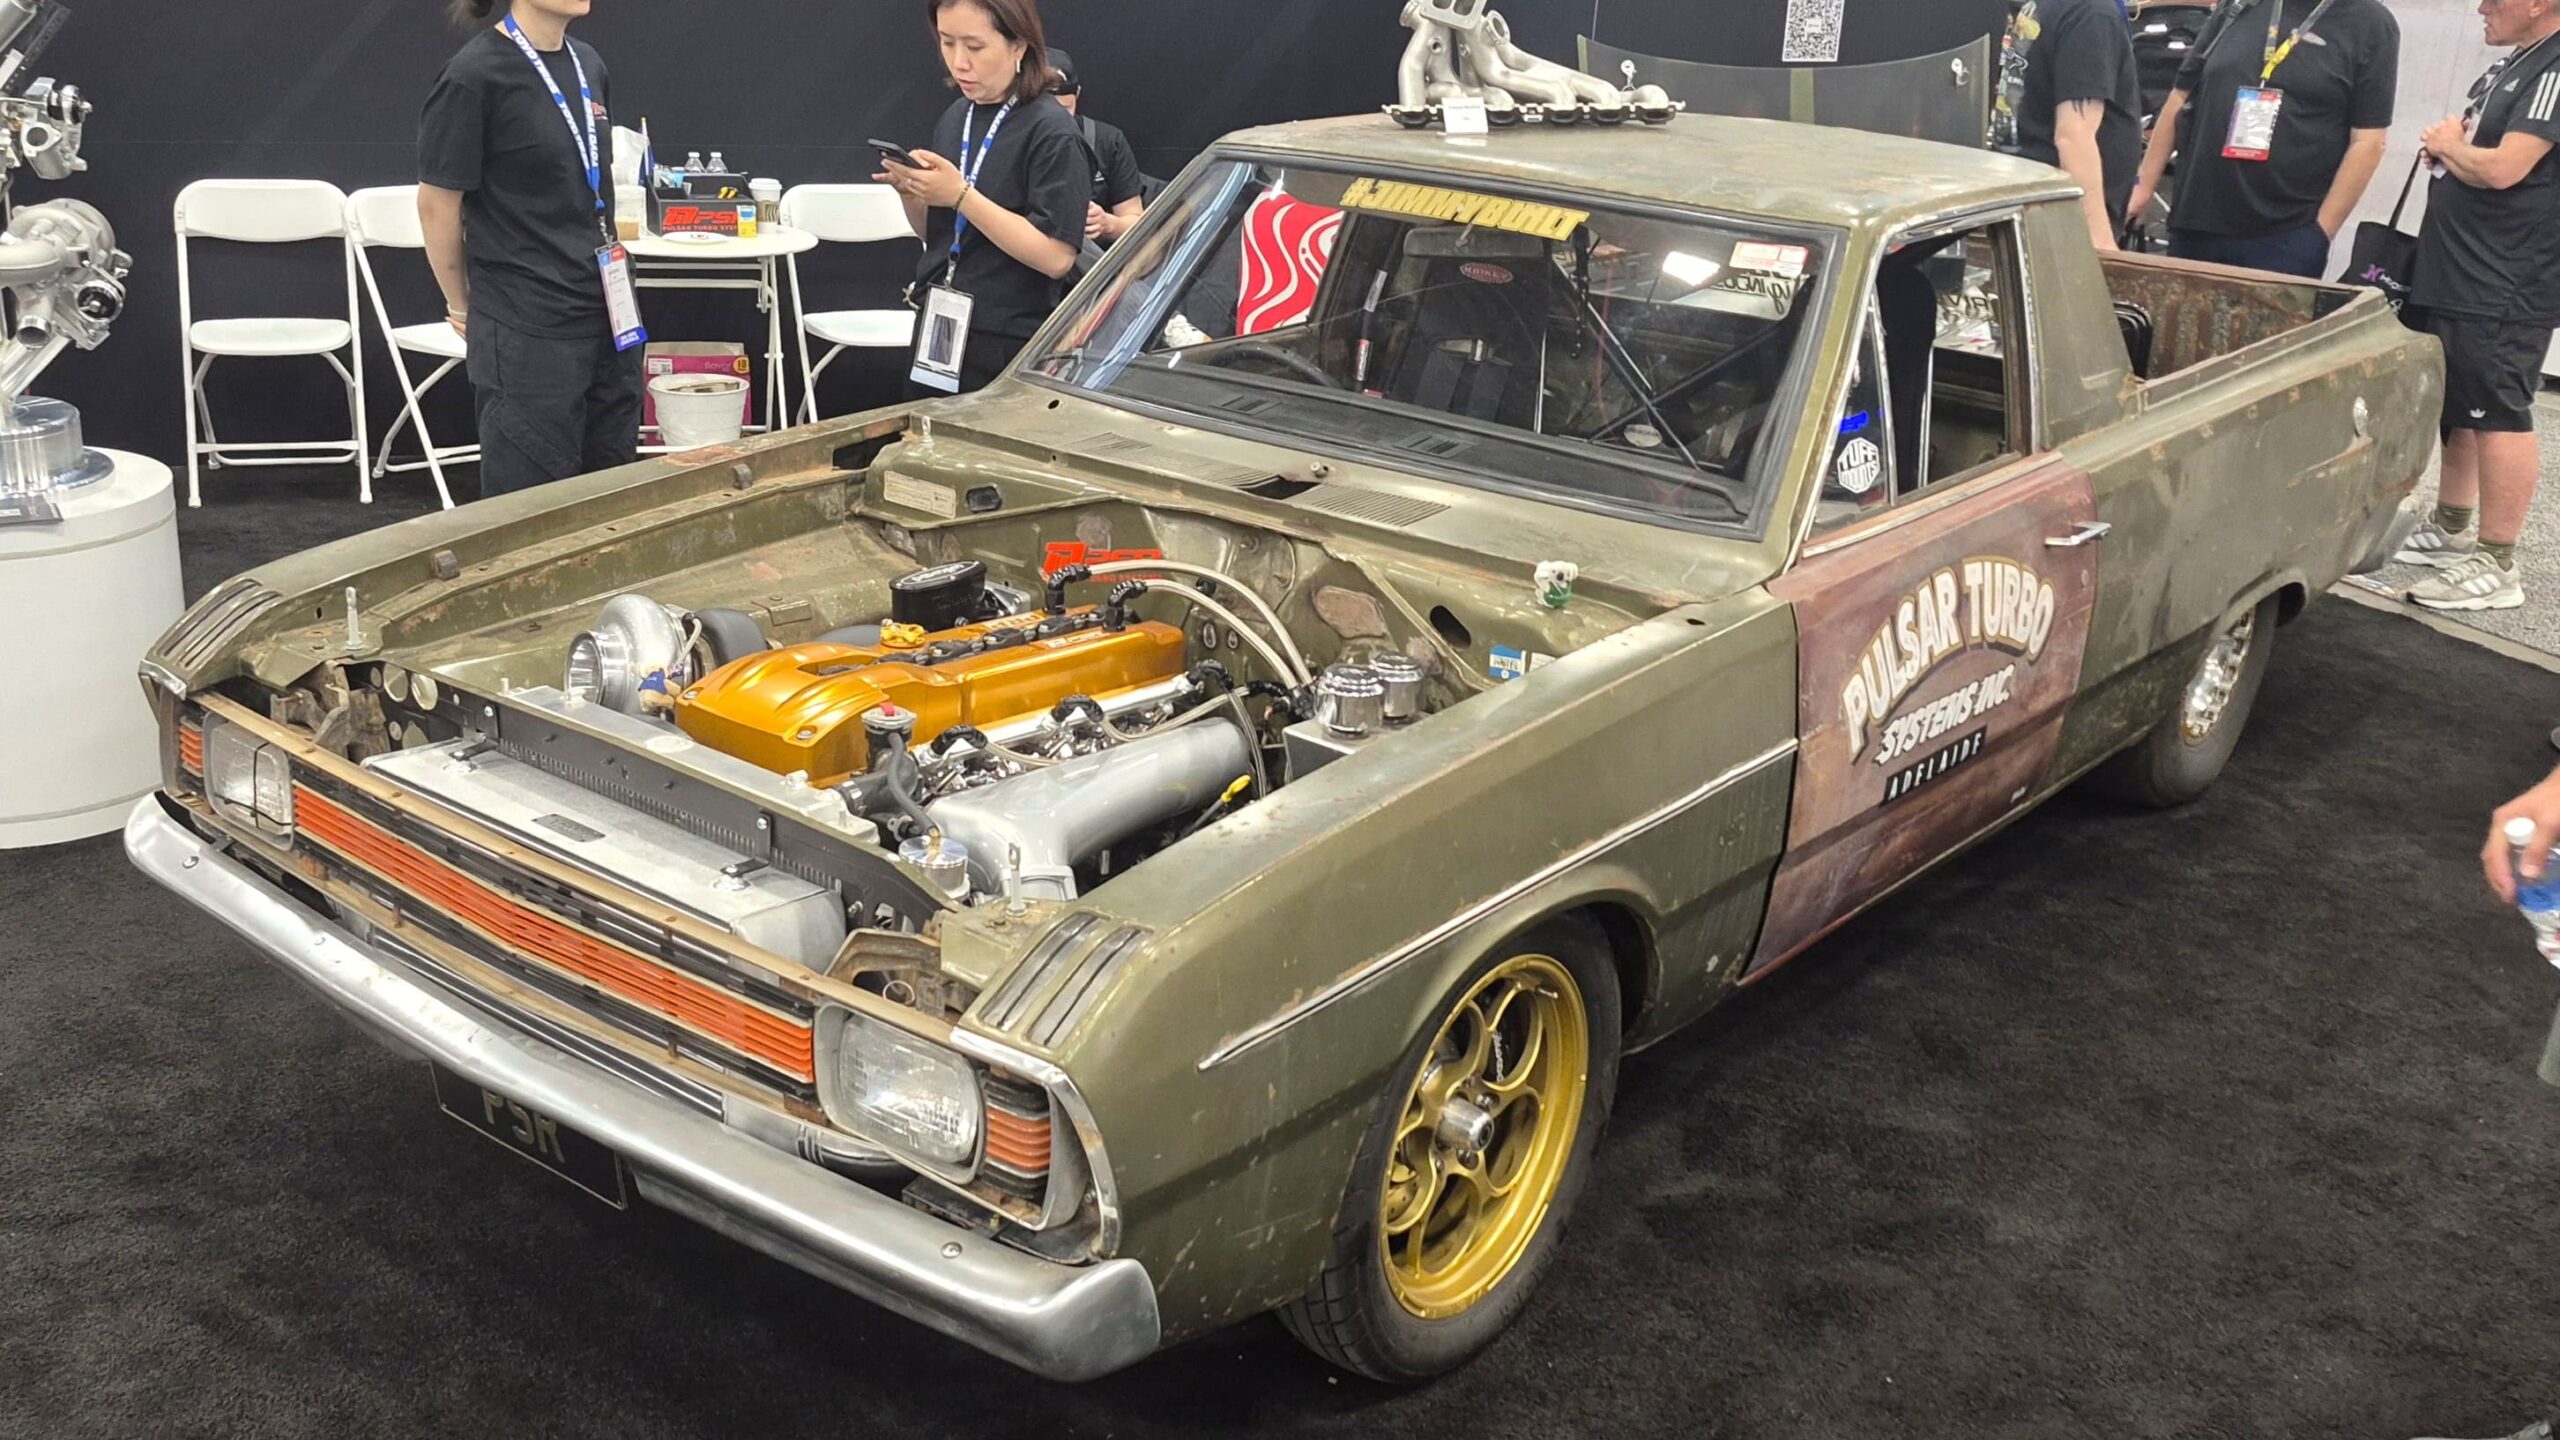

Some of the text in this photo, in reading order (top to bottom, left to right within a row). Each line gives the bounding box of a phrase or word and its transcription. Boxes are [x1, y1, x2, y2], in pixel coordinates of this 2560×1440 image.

[511, 28, 539, 61] TOYO
[1339, 177, 1590, 241] #JIMMYBUILT
[1838, 441, 1877, 471] TUFF
[1842, 560, 2055, 759] PULSAR TURBO
[1874, 681, 1980, 765] SYSTEMS
[1888, 731, 1983, 801] ADELAIDE
